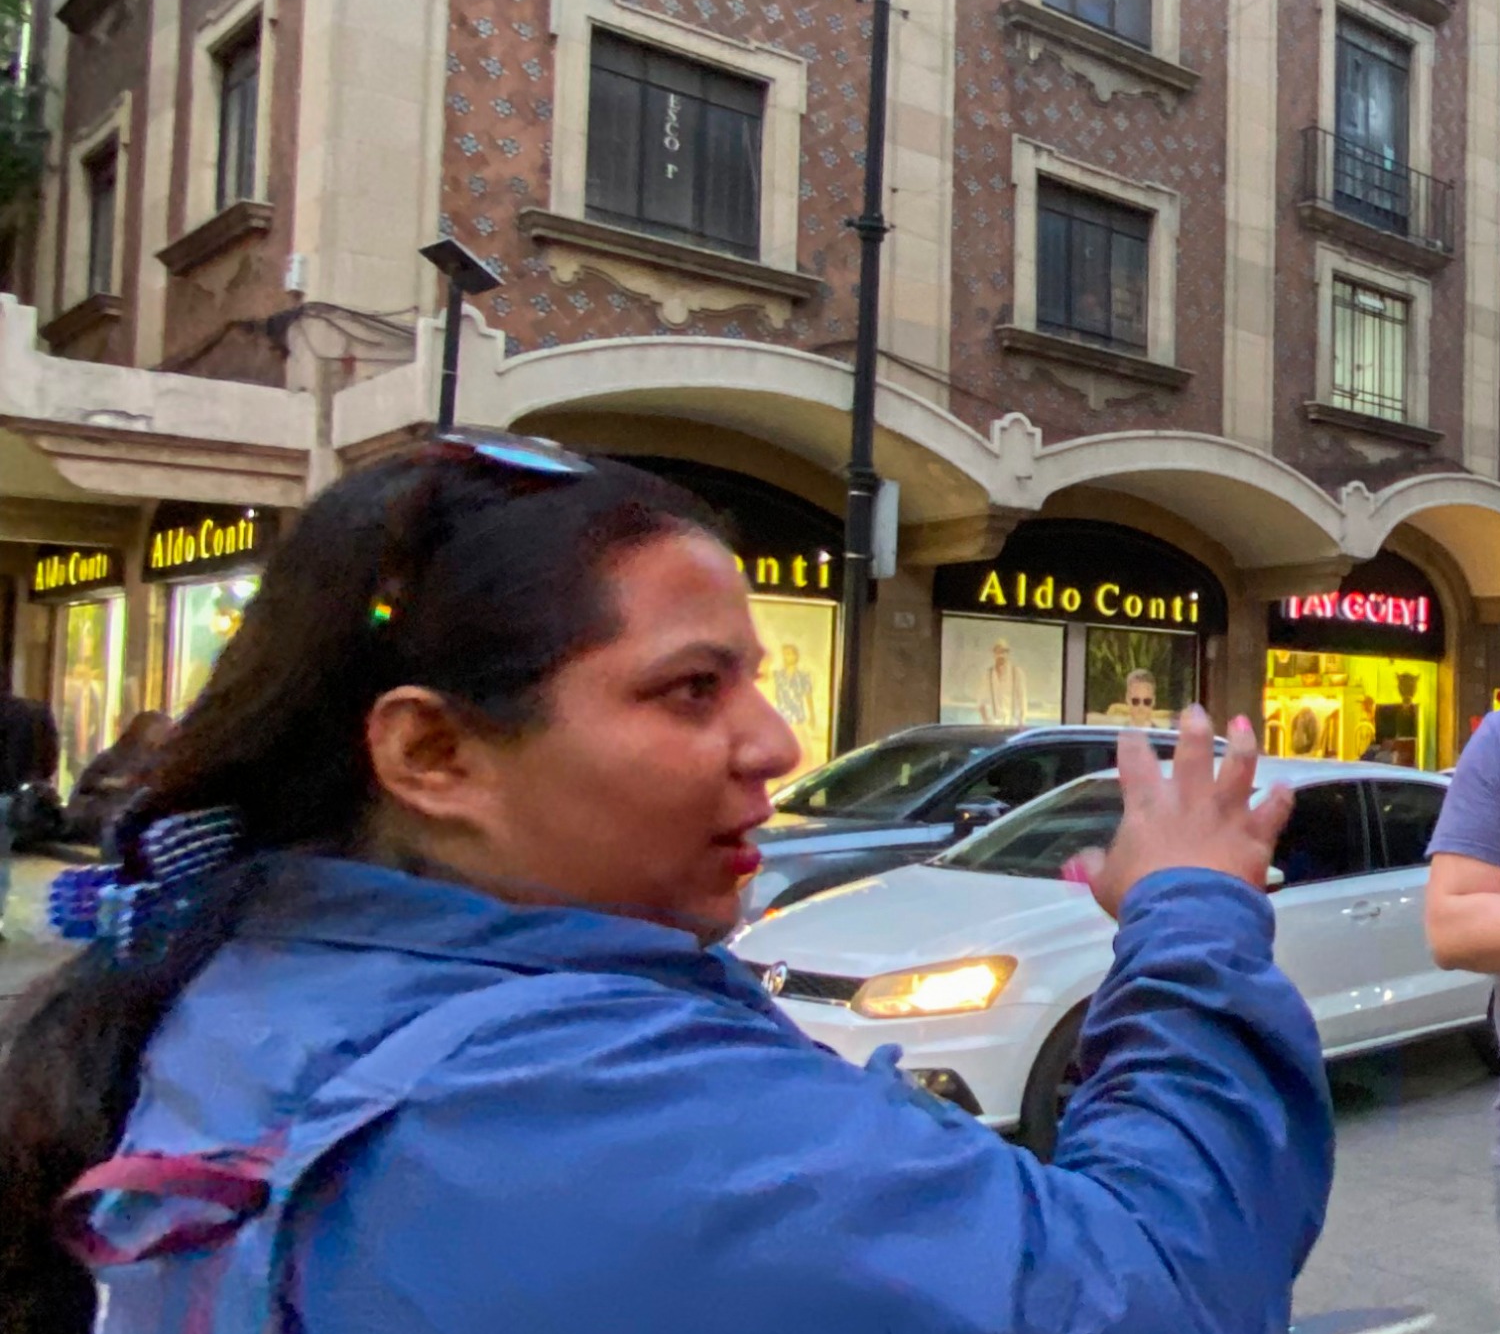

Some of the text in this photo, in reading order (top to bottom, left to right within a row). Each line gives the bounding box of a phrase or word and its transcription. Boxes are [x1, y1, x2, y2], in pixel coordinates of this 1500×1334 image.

[152, 512, 254, 569] Aldo Conti
[34, 551, 108, 591] Aldo Conti
[979, 570, 1199, 623] Aldo Conti
